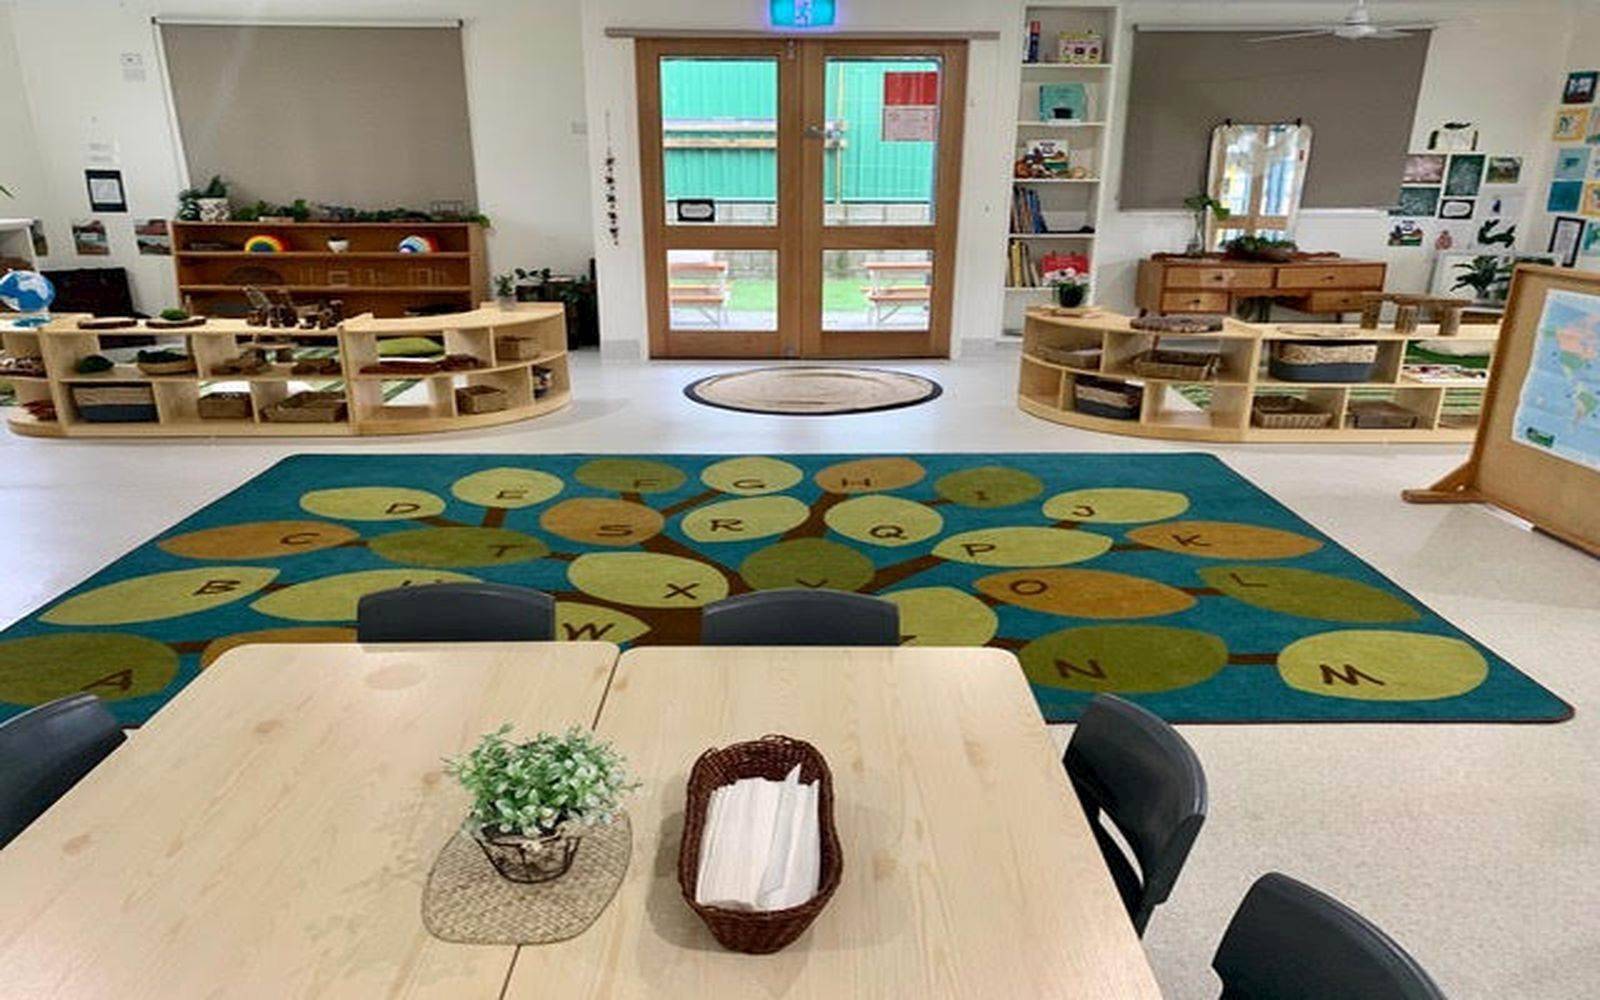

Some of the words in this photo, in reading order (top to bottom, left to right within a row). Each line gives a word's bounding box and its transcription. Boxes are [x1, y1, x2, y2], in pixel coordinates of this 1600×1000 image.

[634, 479, 660, 489] F
[733, 479, 765, 489] G
[841, 478, 872, 489] H
[496, 490, 529, 499] E
[385, 503, 420, 515] D
[1072, 505, 1096, 518] J
[597, 525, 633, 537] S
[711, 519, 743, 532] R
[281, 533, 320, 547] C
[870, 525, 907, 541] Q
[1172, 534, 1211, 547] K
[490, 544, 523, 557] T
[962, 543, 996, 557] P
[1229, 572, 1268, 588] L
[193, 579, 241, 597] B
[665, 582, 700, 600] X
[1009, 579, 1048, 596] O
[563, 621, 614, 640] W
[1055, 658, 1108, 680] N
[1318, 663, 1385, 687] M
[83, 668, 134, 692] A
